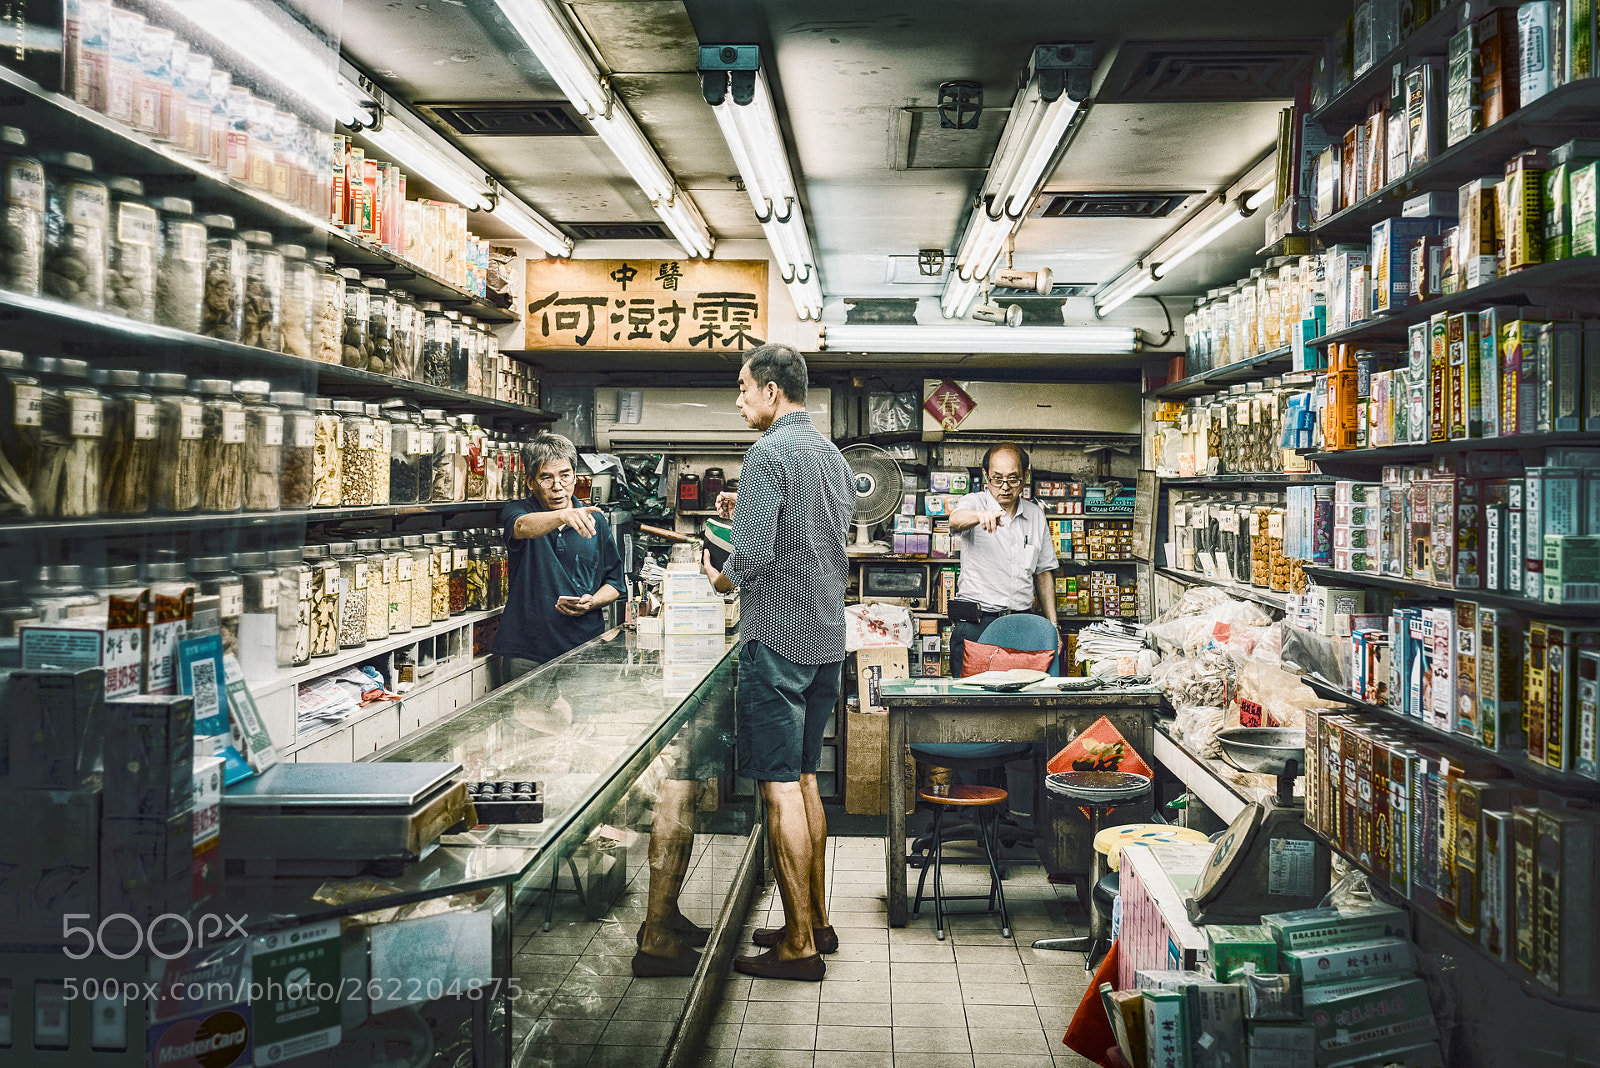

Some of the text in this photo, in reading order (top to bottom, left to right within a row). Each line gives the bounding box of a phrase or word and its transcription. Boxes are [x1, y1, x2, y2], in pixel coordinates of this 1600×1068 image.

[610, 262, 683, 291] 中醫
[937, 391, 961, 416] 春
[1346, 951, 1393, 968] 蛇舌草精
[158, 1027, 246, 1064] MasterCard
